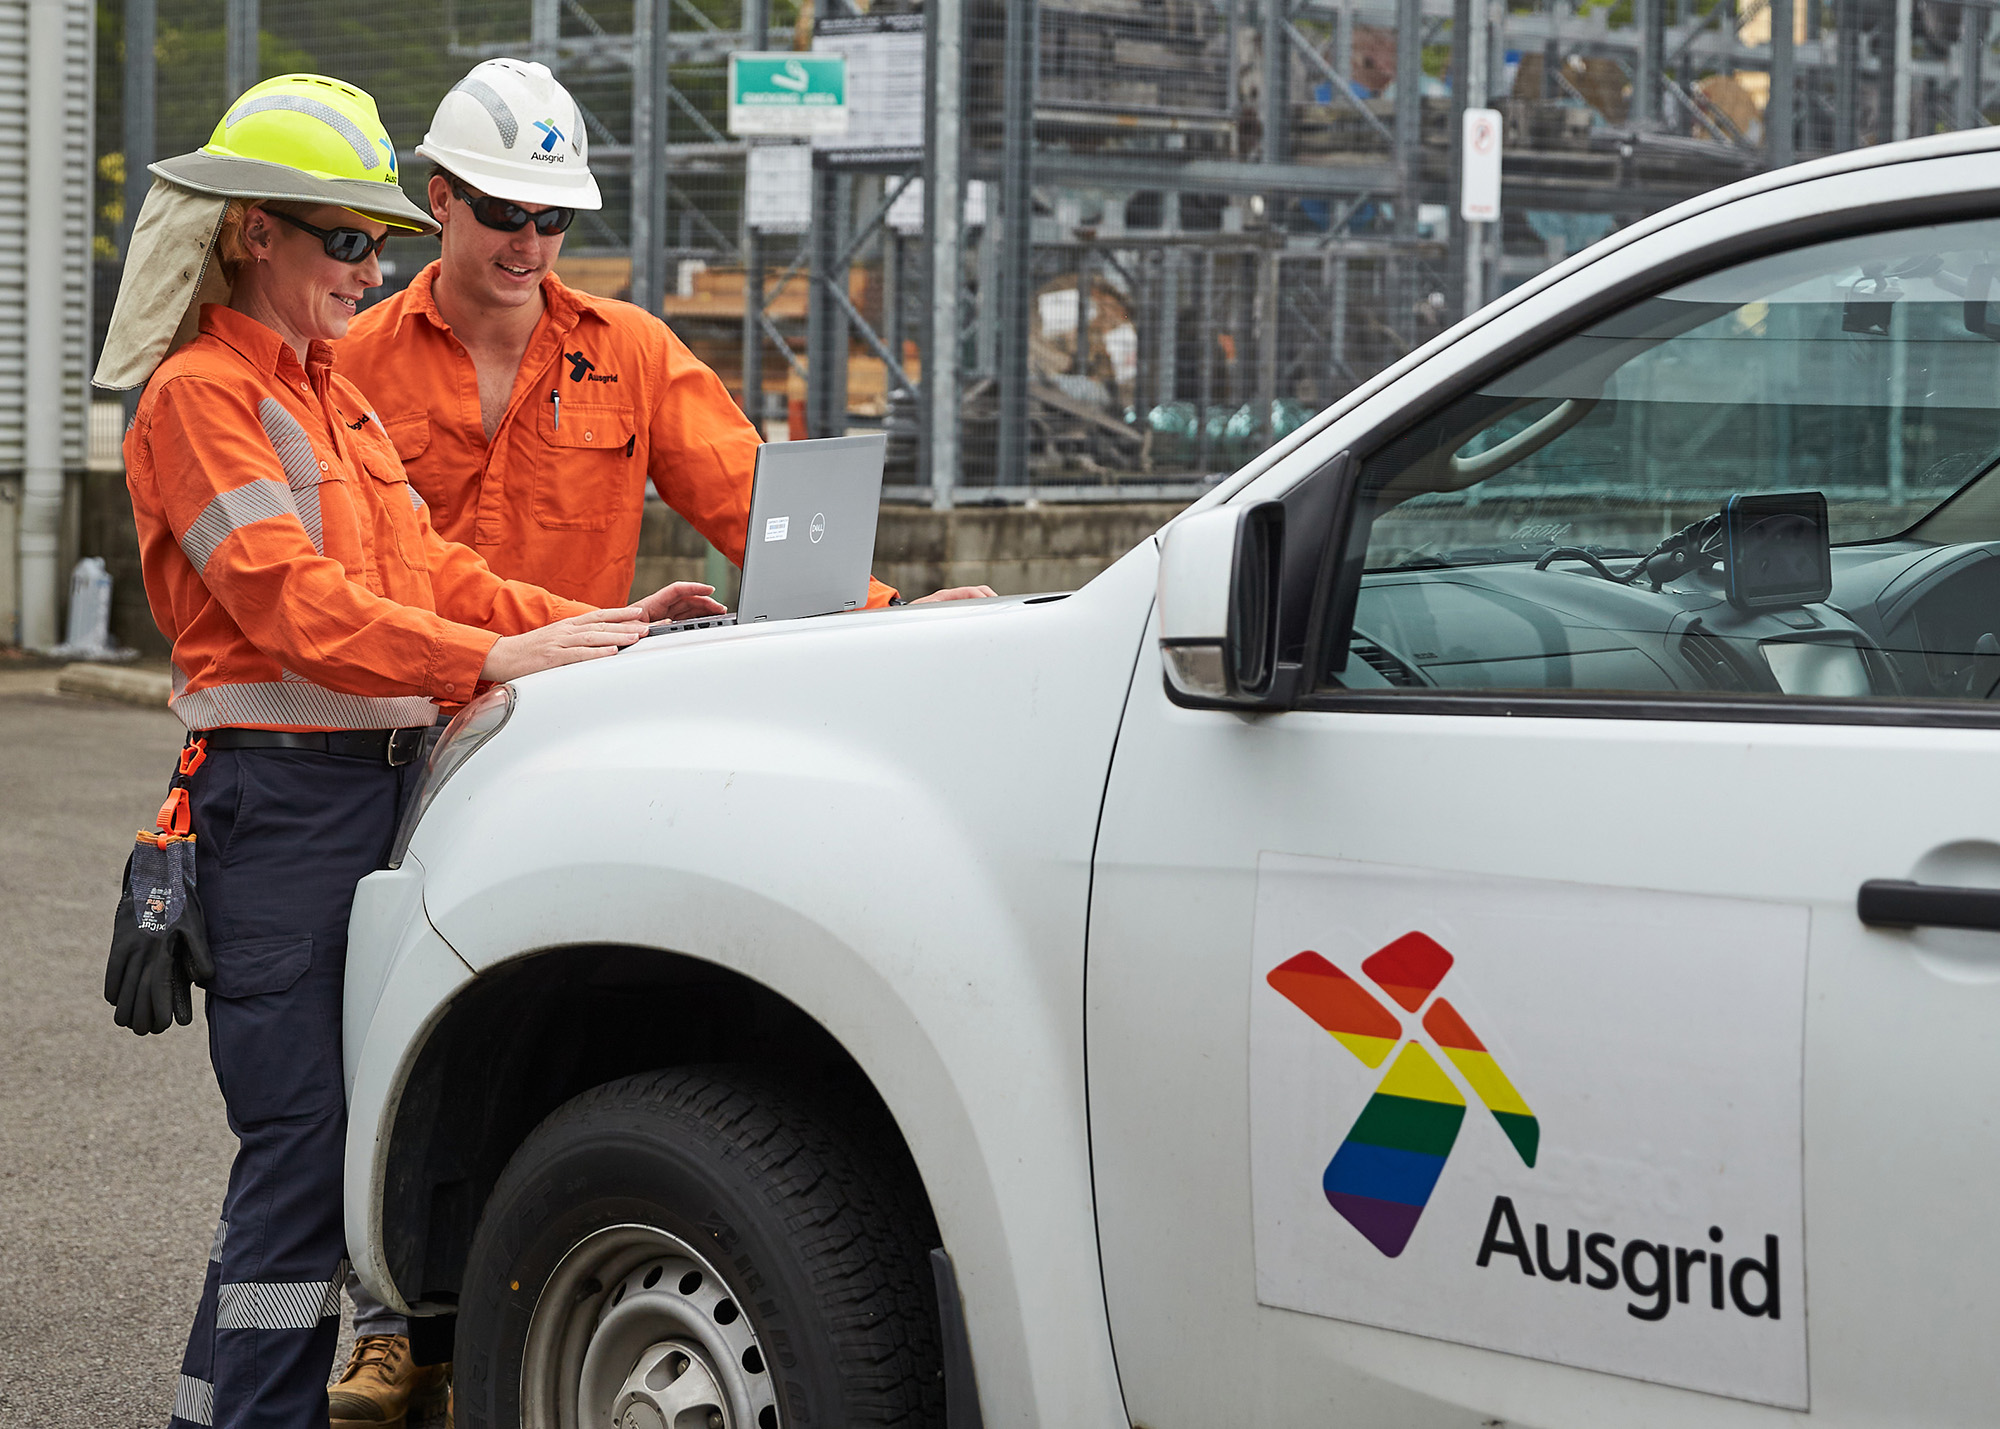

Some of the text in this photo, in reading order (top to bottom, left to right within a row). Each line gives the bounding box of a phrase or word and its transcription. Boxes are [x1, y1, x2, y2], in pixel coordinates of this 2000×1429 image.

[530, 151, 564, 163] Ausgrid
[588, 372, 618, 384] Ausgrid
[812, 523, 823, 532] DELL
[1475, 1195, 1781, 1321] Ausgrid
